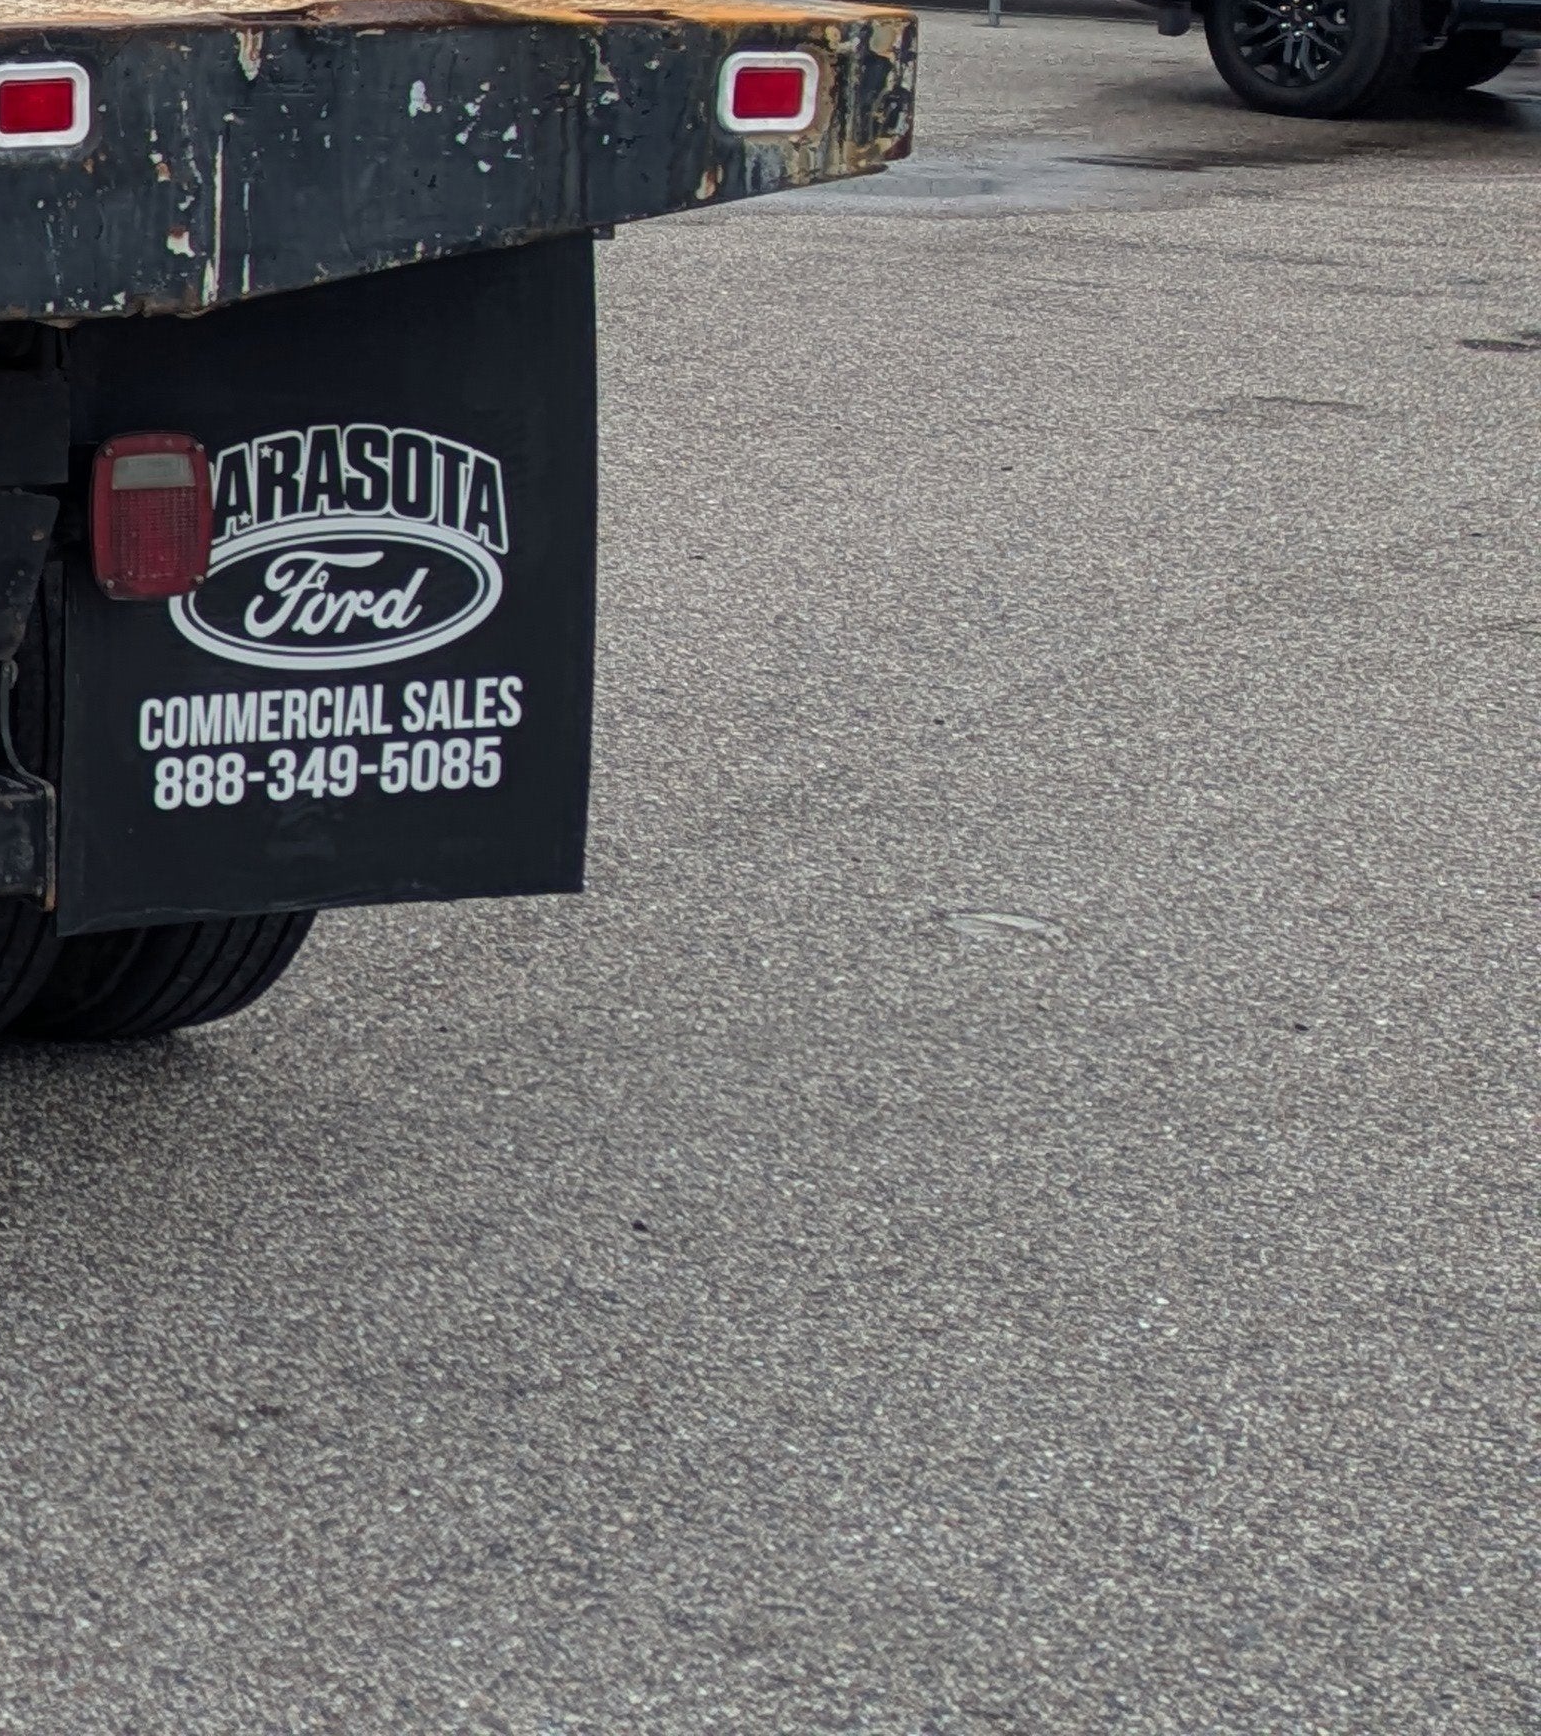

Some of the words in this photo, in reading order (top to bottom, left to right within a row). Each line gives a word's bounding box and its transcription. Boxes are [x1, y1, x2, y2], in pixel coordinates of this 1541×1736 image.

[209, 424, 509, 554] ARASOTA
[244, 551, 429, 638] Ford
[139, 685, 391, 751] COMMERCIAL
[402, 676, 523, 732] SALES
[153, 736, 501, 810] 888-349-5085
